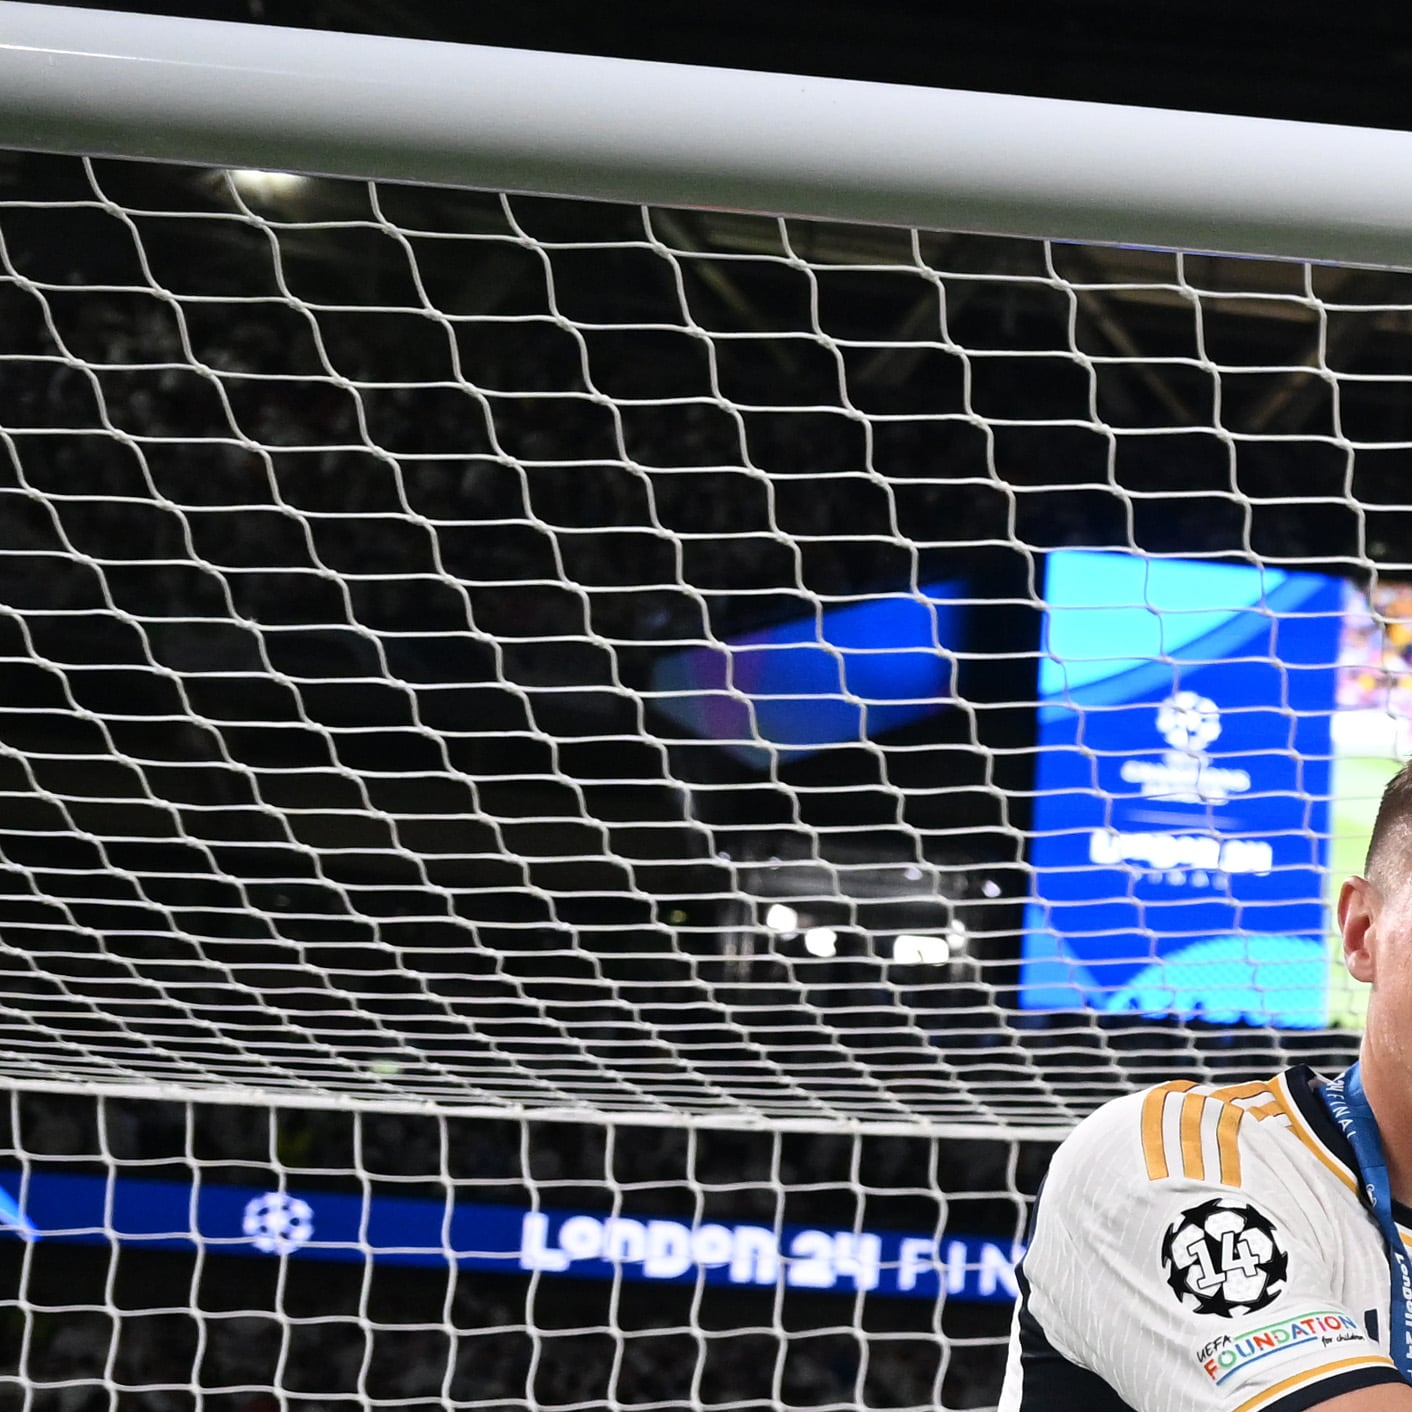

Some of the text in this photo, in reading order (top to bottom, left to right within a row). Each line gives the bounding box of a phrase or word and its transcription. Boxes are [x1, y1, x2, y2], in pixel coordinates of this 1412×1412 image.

[1326, 1093, 1357, 1140] FINAL
[787, 1228, 882, 1290] 24
[898, 1236, 1025, 1298] FIN
[1186, 1230, 1260, 1290] 14
[1196, 1334, 1233, 1363] UEFA
[1321, 1334, 1333, 1348] for
